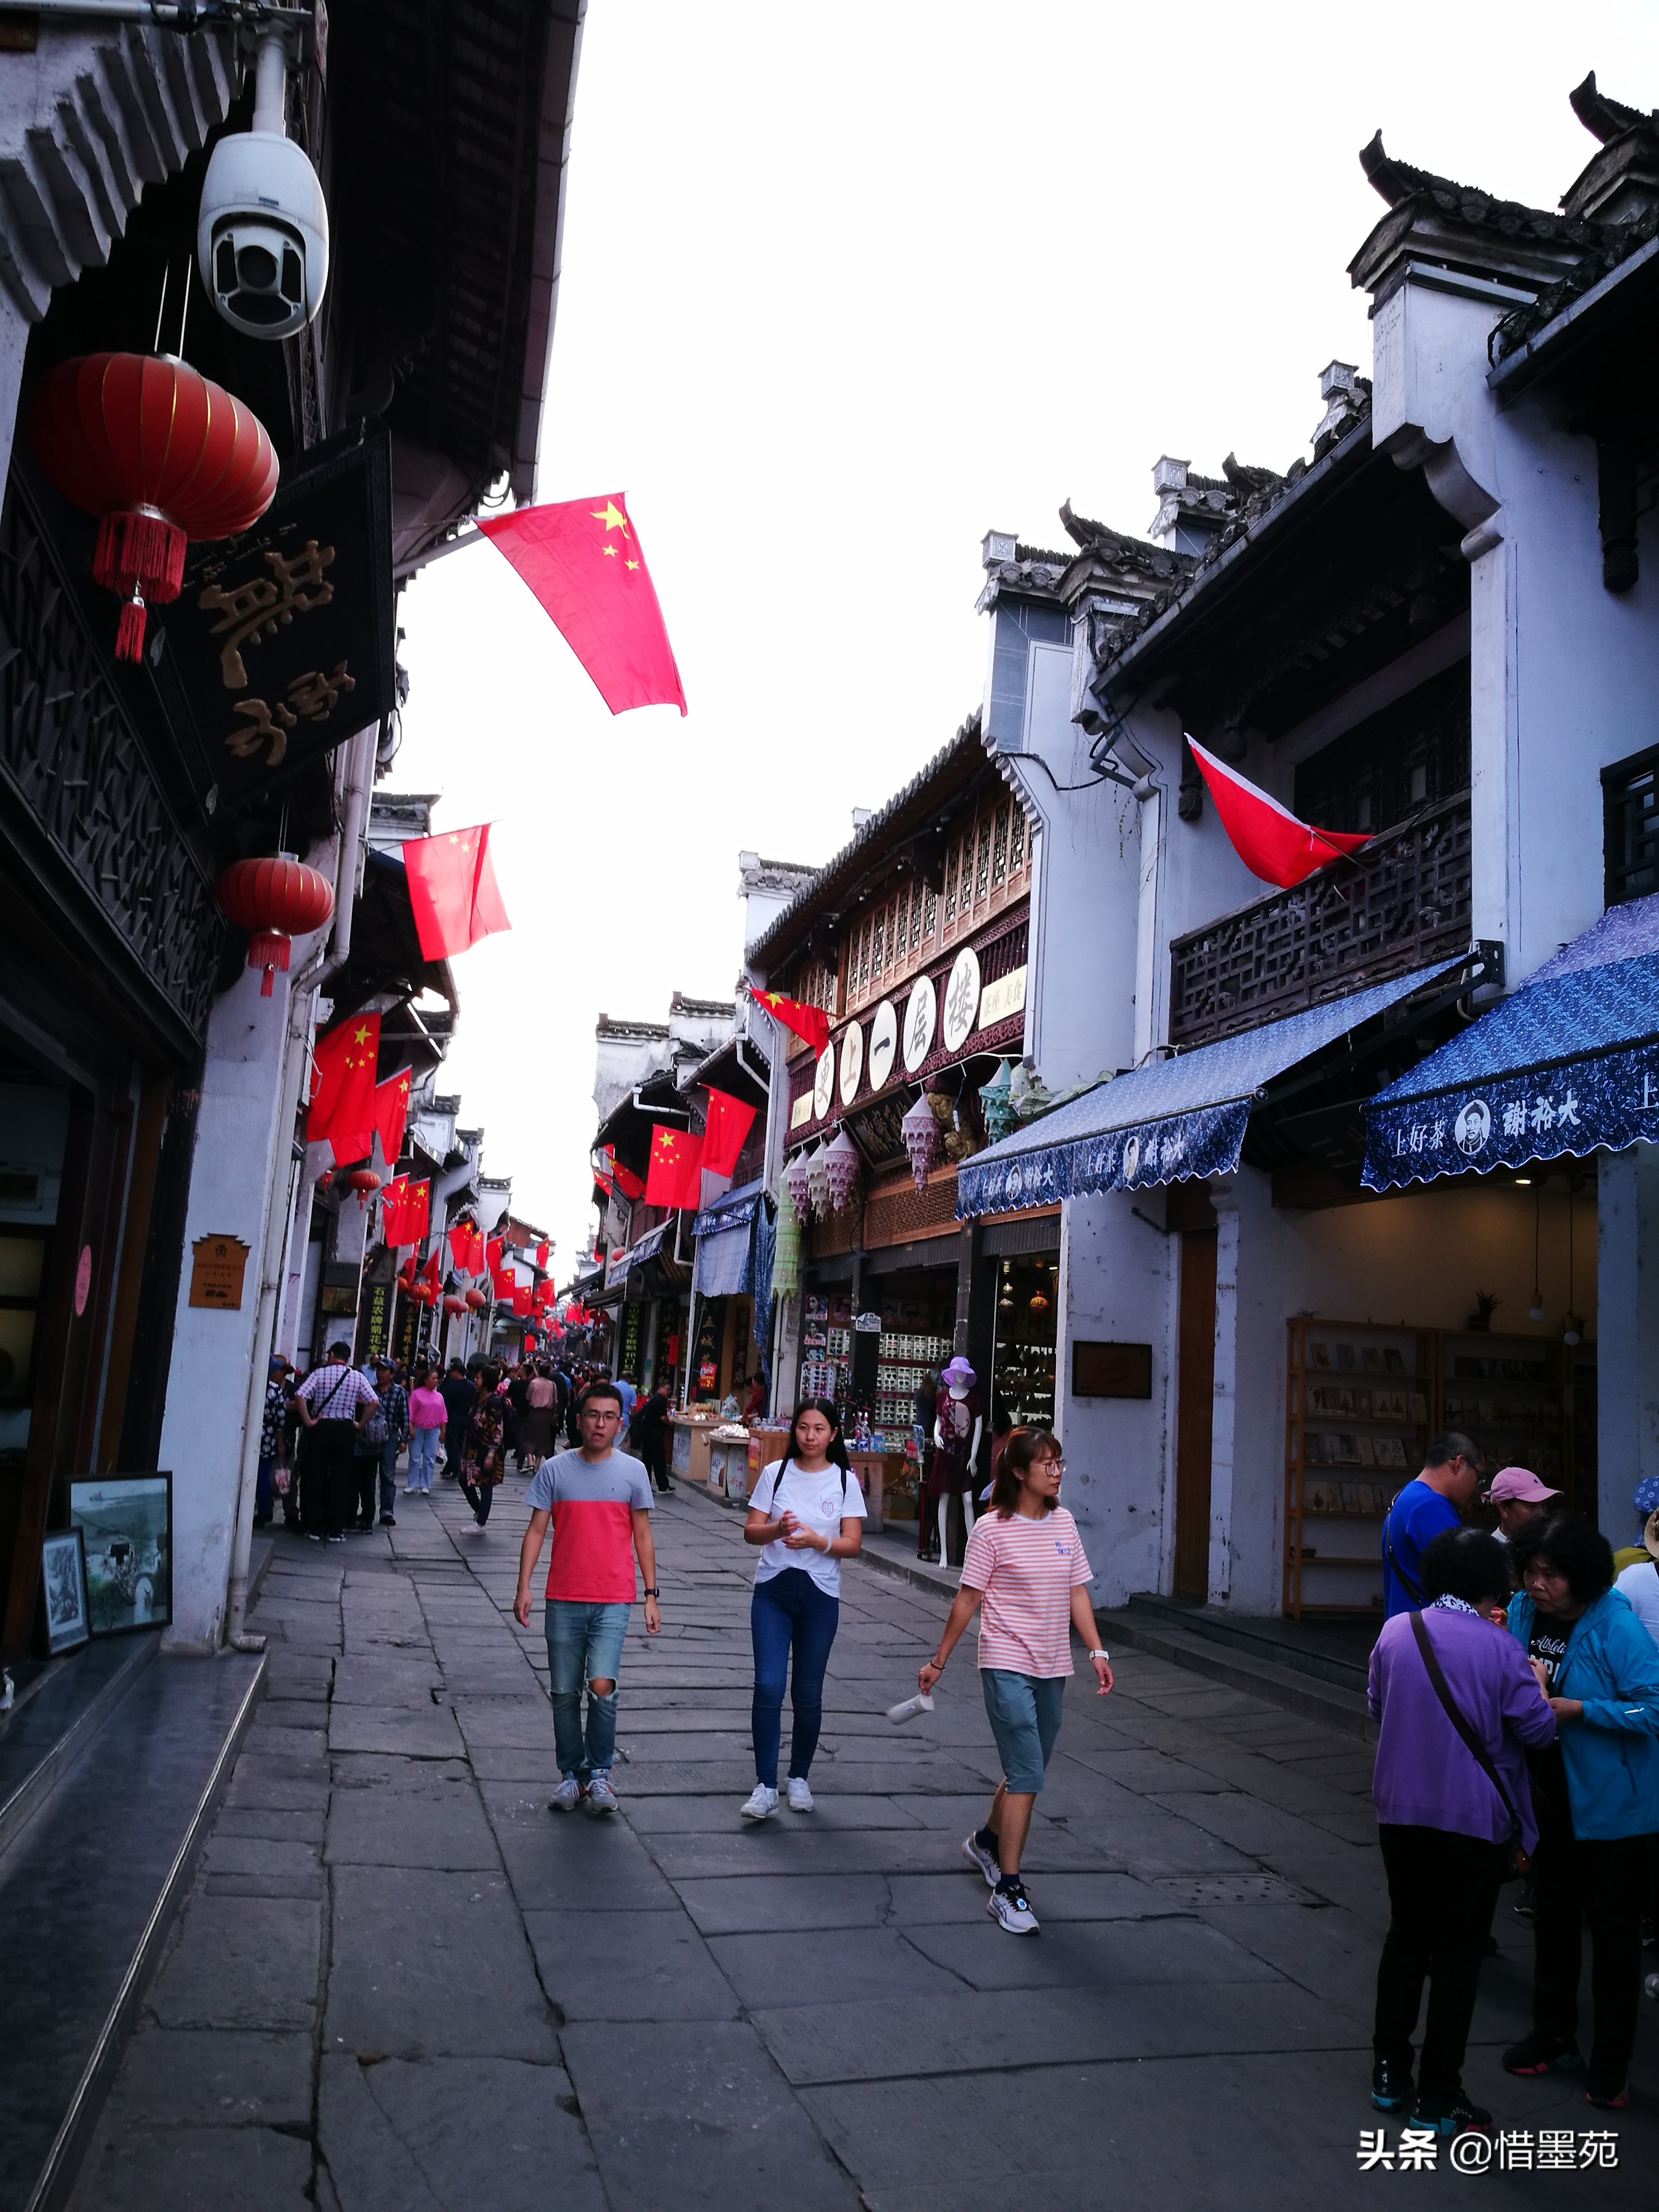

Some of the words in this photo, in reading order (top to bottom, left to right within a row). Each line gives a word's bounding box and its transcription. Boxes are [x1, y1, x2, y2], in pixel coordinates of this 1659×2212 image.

[817, 962, 974, 1105] 更上一层楼
[1391, 1119, 1447, 1158] 上好茶
[1503, 1090, 1581, 1137] 謝裕大
[1530, 1634, 1566, 1655] Athleti
